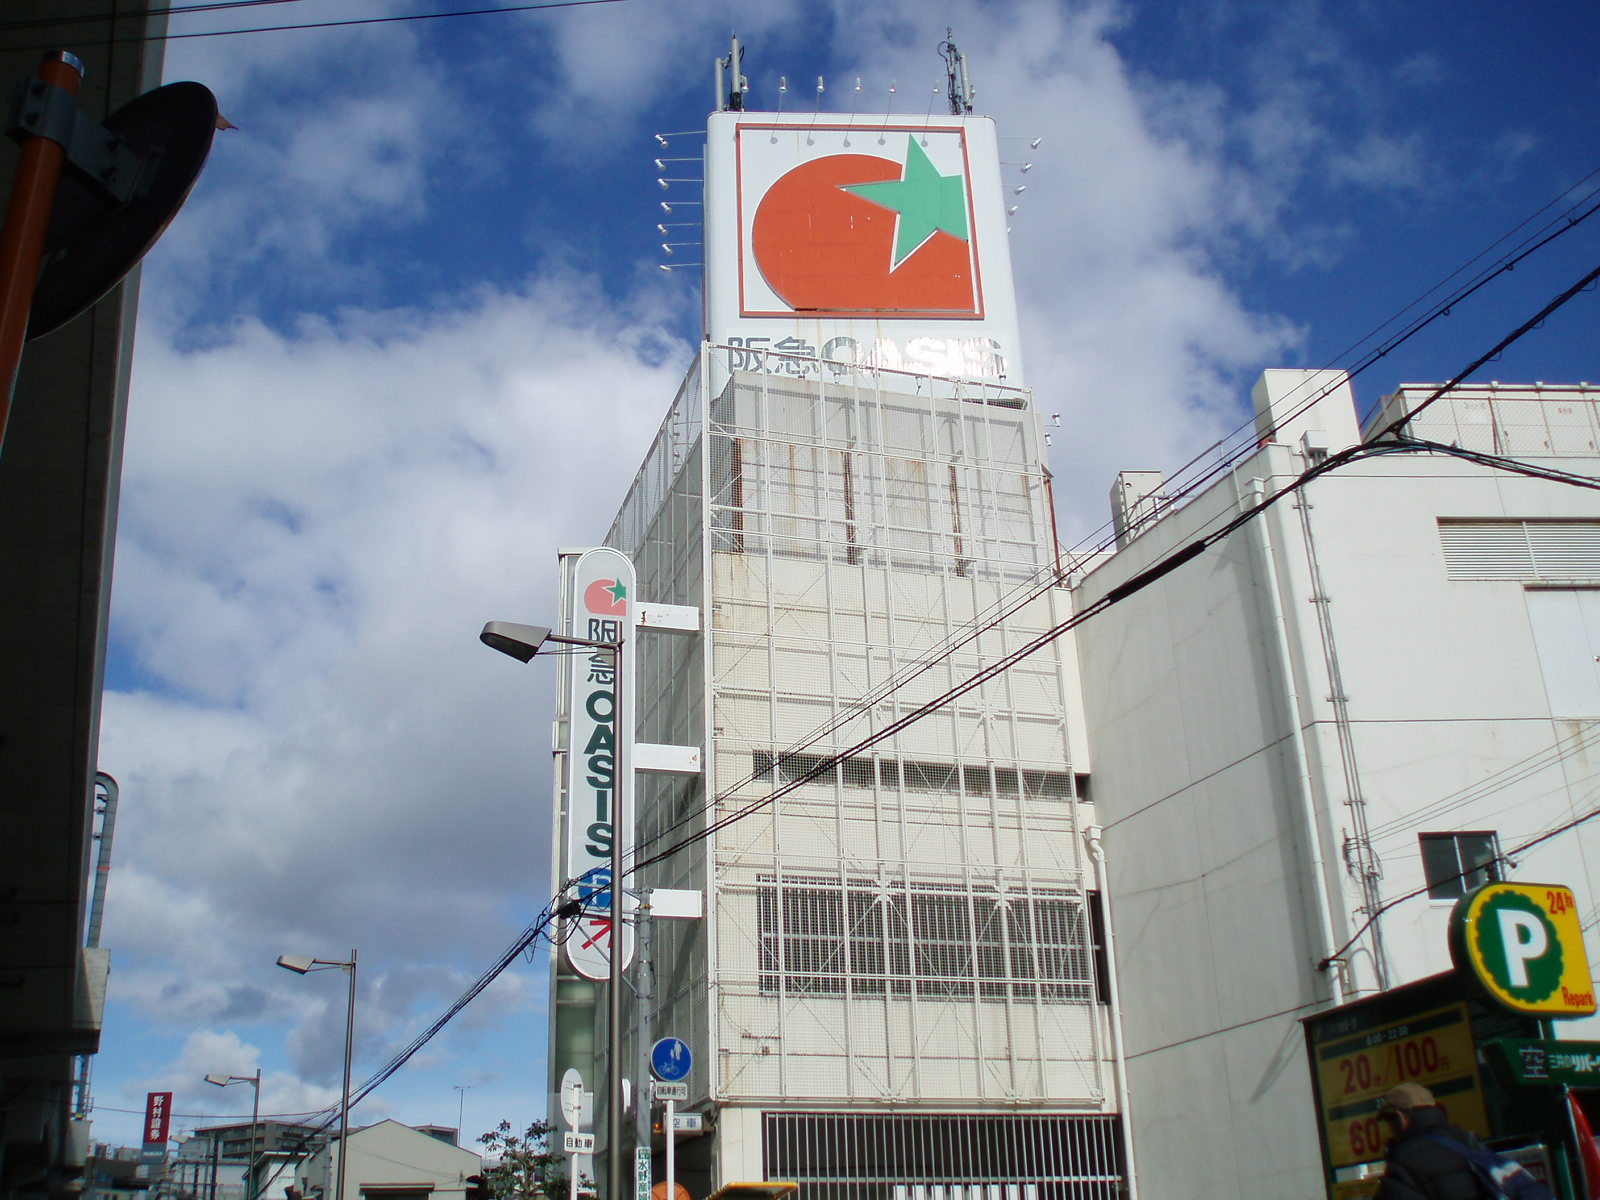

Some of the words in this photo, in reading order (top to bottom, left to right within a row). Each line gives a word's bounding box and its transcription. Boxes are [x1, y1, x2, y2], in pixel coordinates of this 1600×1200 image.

[1496, 908, 1548, 988] P
[1561, 986, 1595, 1008] Repark
[565, 1136, 593, 1149] 自動車
